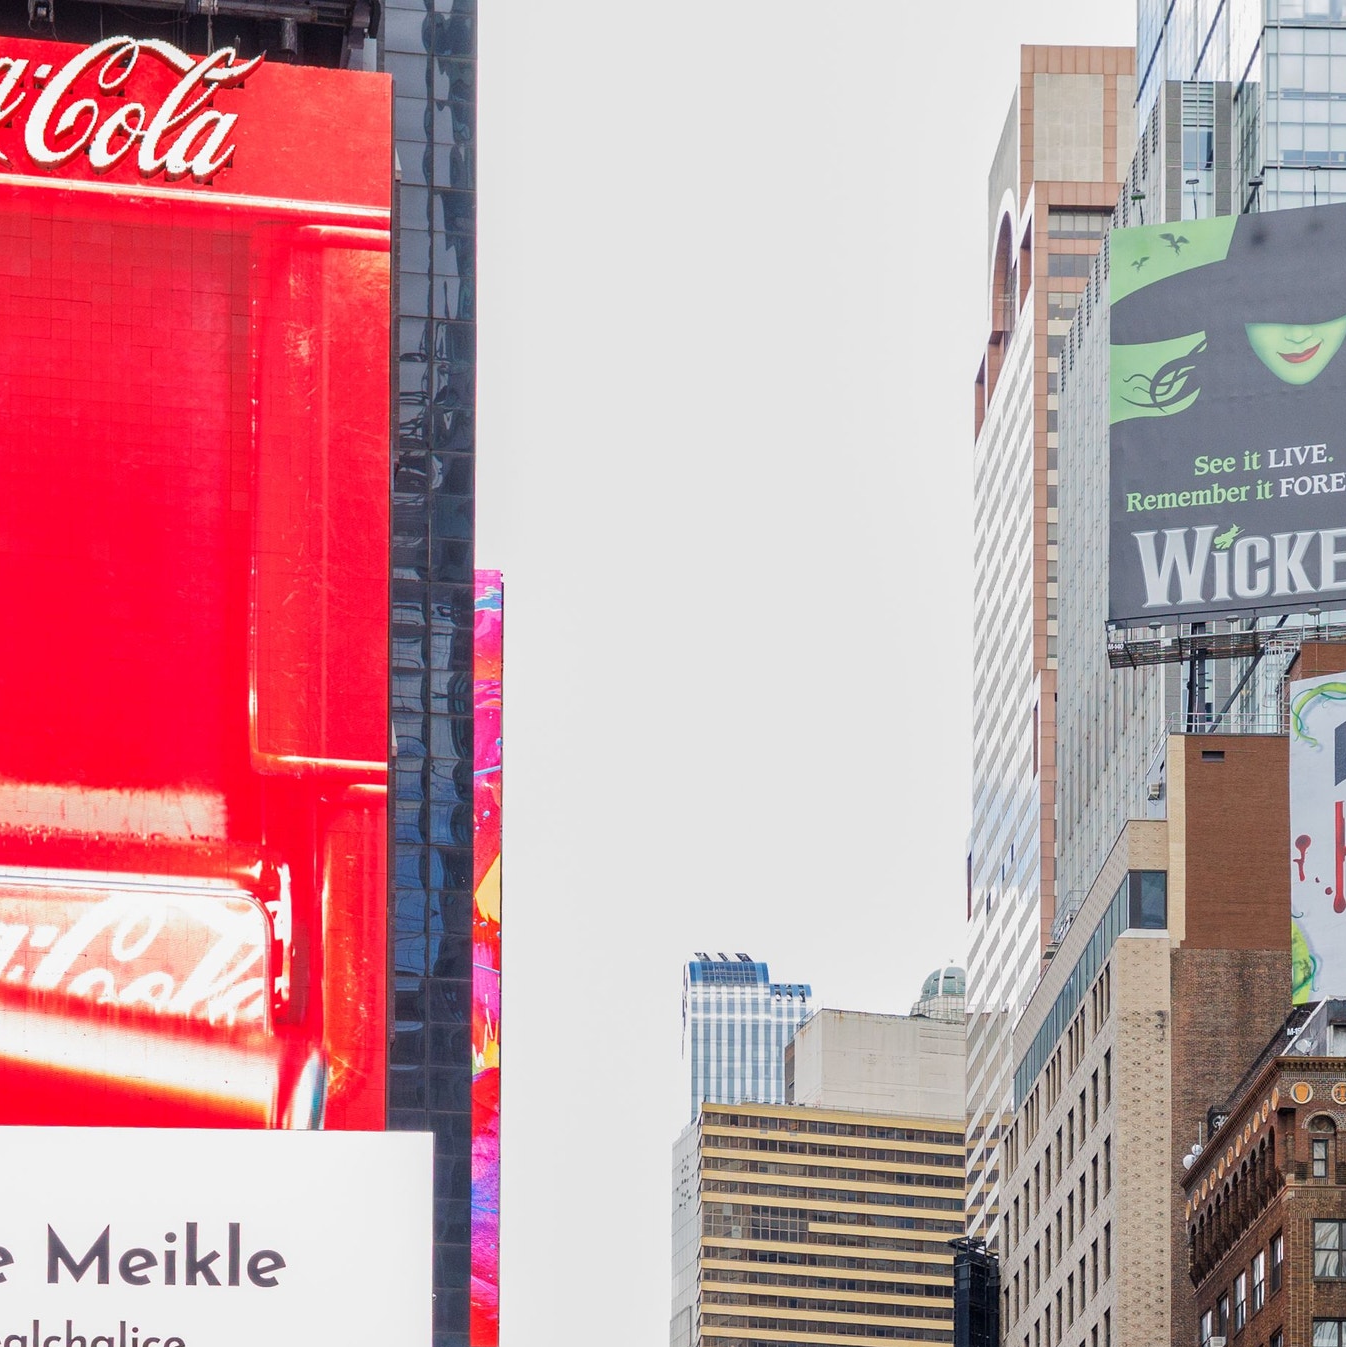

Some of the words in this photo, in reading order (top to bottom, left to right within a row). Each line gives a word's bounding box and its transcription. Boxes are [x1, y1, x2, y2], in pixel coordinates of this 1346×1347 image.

[1194, 453, 1236, 476] See
[1243, 449, 1261, 472] it
[1268, 443, 1334, 470] LIVE.
[1126, 482, 1248, 513] Remember
[1256, 480, 1274, 502] it
[47, 1221, 288, 1288] Meikle
